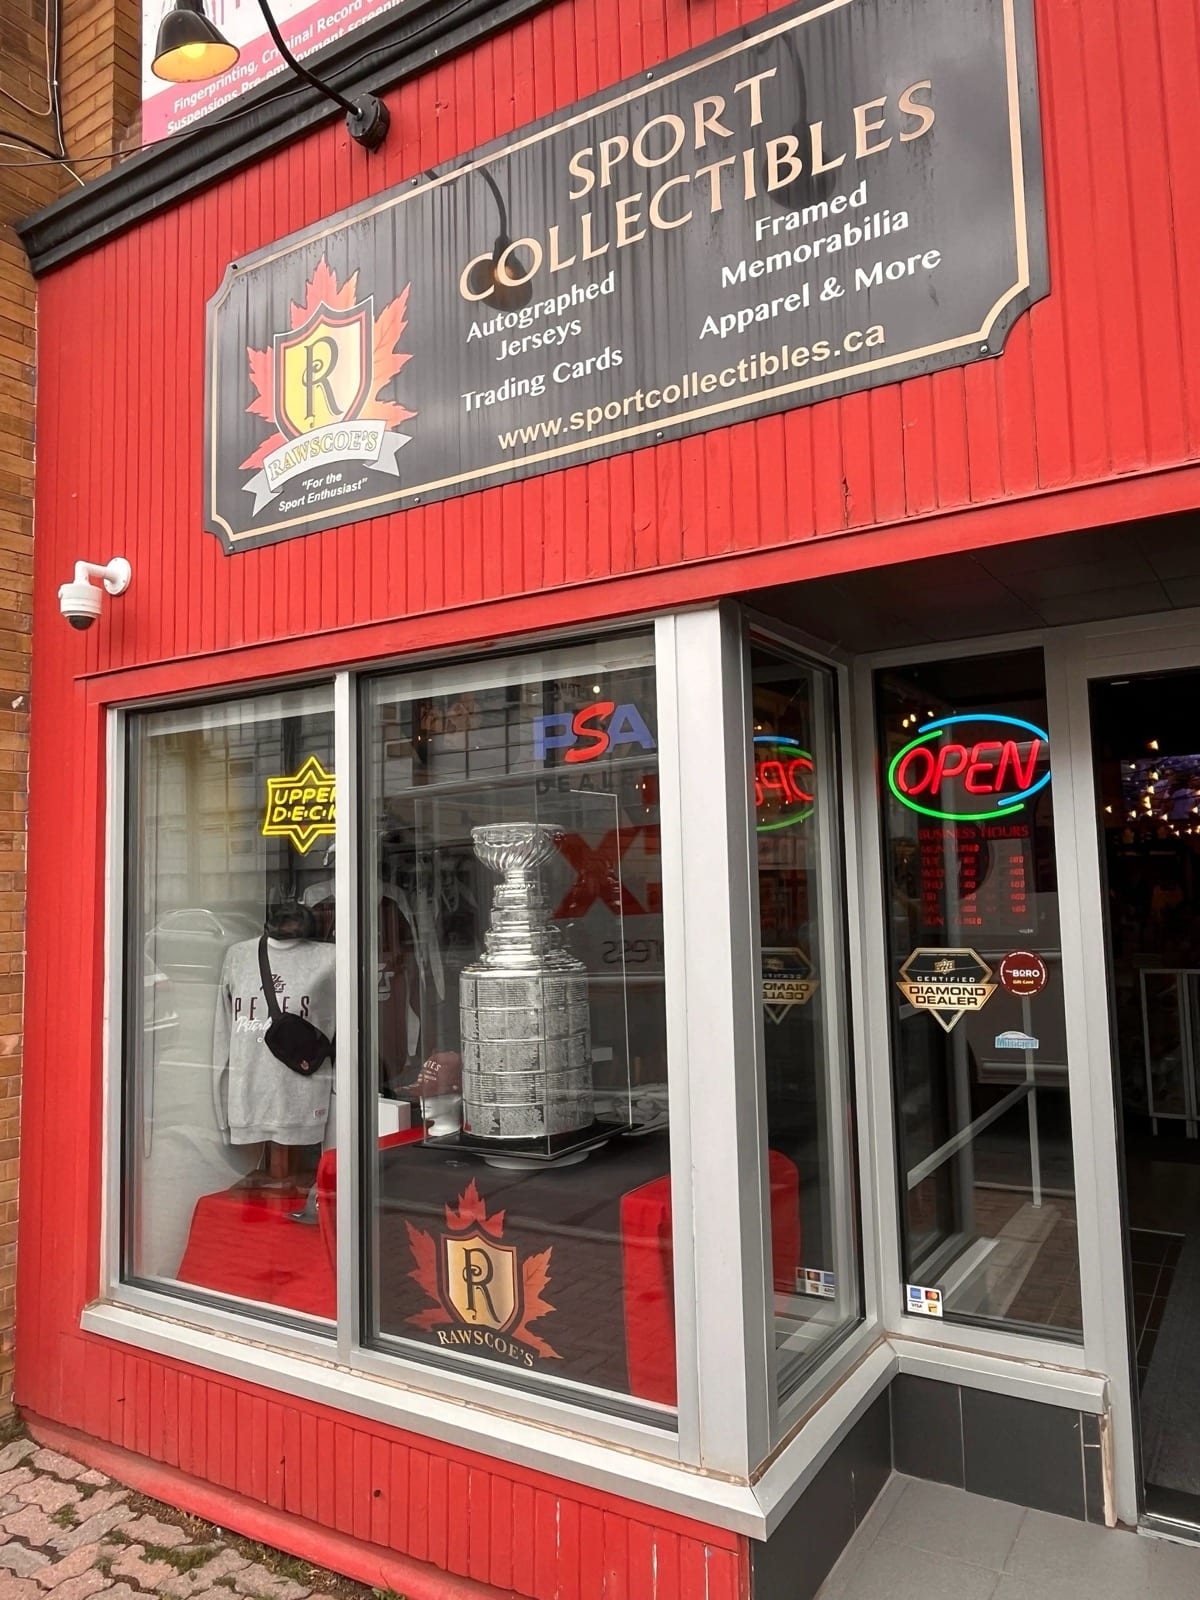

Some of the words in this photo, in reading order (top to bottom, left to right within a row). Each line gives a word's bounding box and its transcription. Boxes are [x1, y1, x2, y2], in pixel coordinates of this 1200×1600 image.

[174, 61, 257, 112] Fingerprinting,
[317, 0, 362, 33] Record
[568, 67, 777, 200] SPORT
[459, 79, 935, 301] COLLECTIBLES
[755, 179, 867, 241] Framed
[721, 209, 909, 288] Memorabilia
[466, 270, 615, 343] Autographed
[699, 282, 810, 339] Apparel
[819, 276, 845, 301] &
[854, 249, 942, 292] More
[496, 319, 582, 361] Jerseys
[461, 373, 546, 412] Trading
[552, 346, 623, 384] Cards
[498, 324, 885, 450] www.sportcollectibles.ca
[268, 430, 379, 481] RAWSCOE'S
[325, 472, 342, 486] the
[279, 496, 305, 512] Sport
[533, 701, 657, 763] PSA
[898, 739, 1041, 795] OPEN
[981, 825, 1029, 838] HOURS
[909, 986, 986, 997] DIAMOND
[915, 996, 978, 1006] DEALER
[1012, 969, 1040, 978] BORO
[234, 996, 310, 1022] PEES
[437, 1329, 534, 1367] RAWSCOE'S
